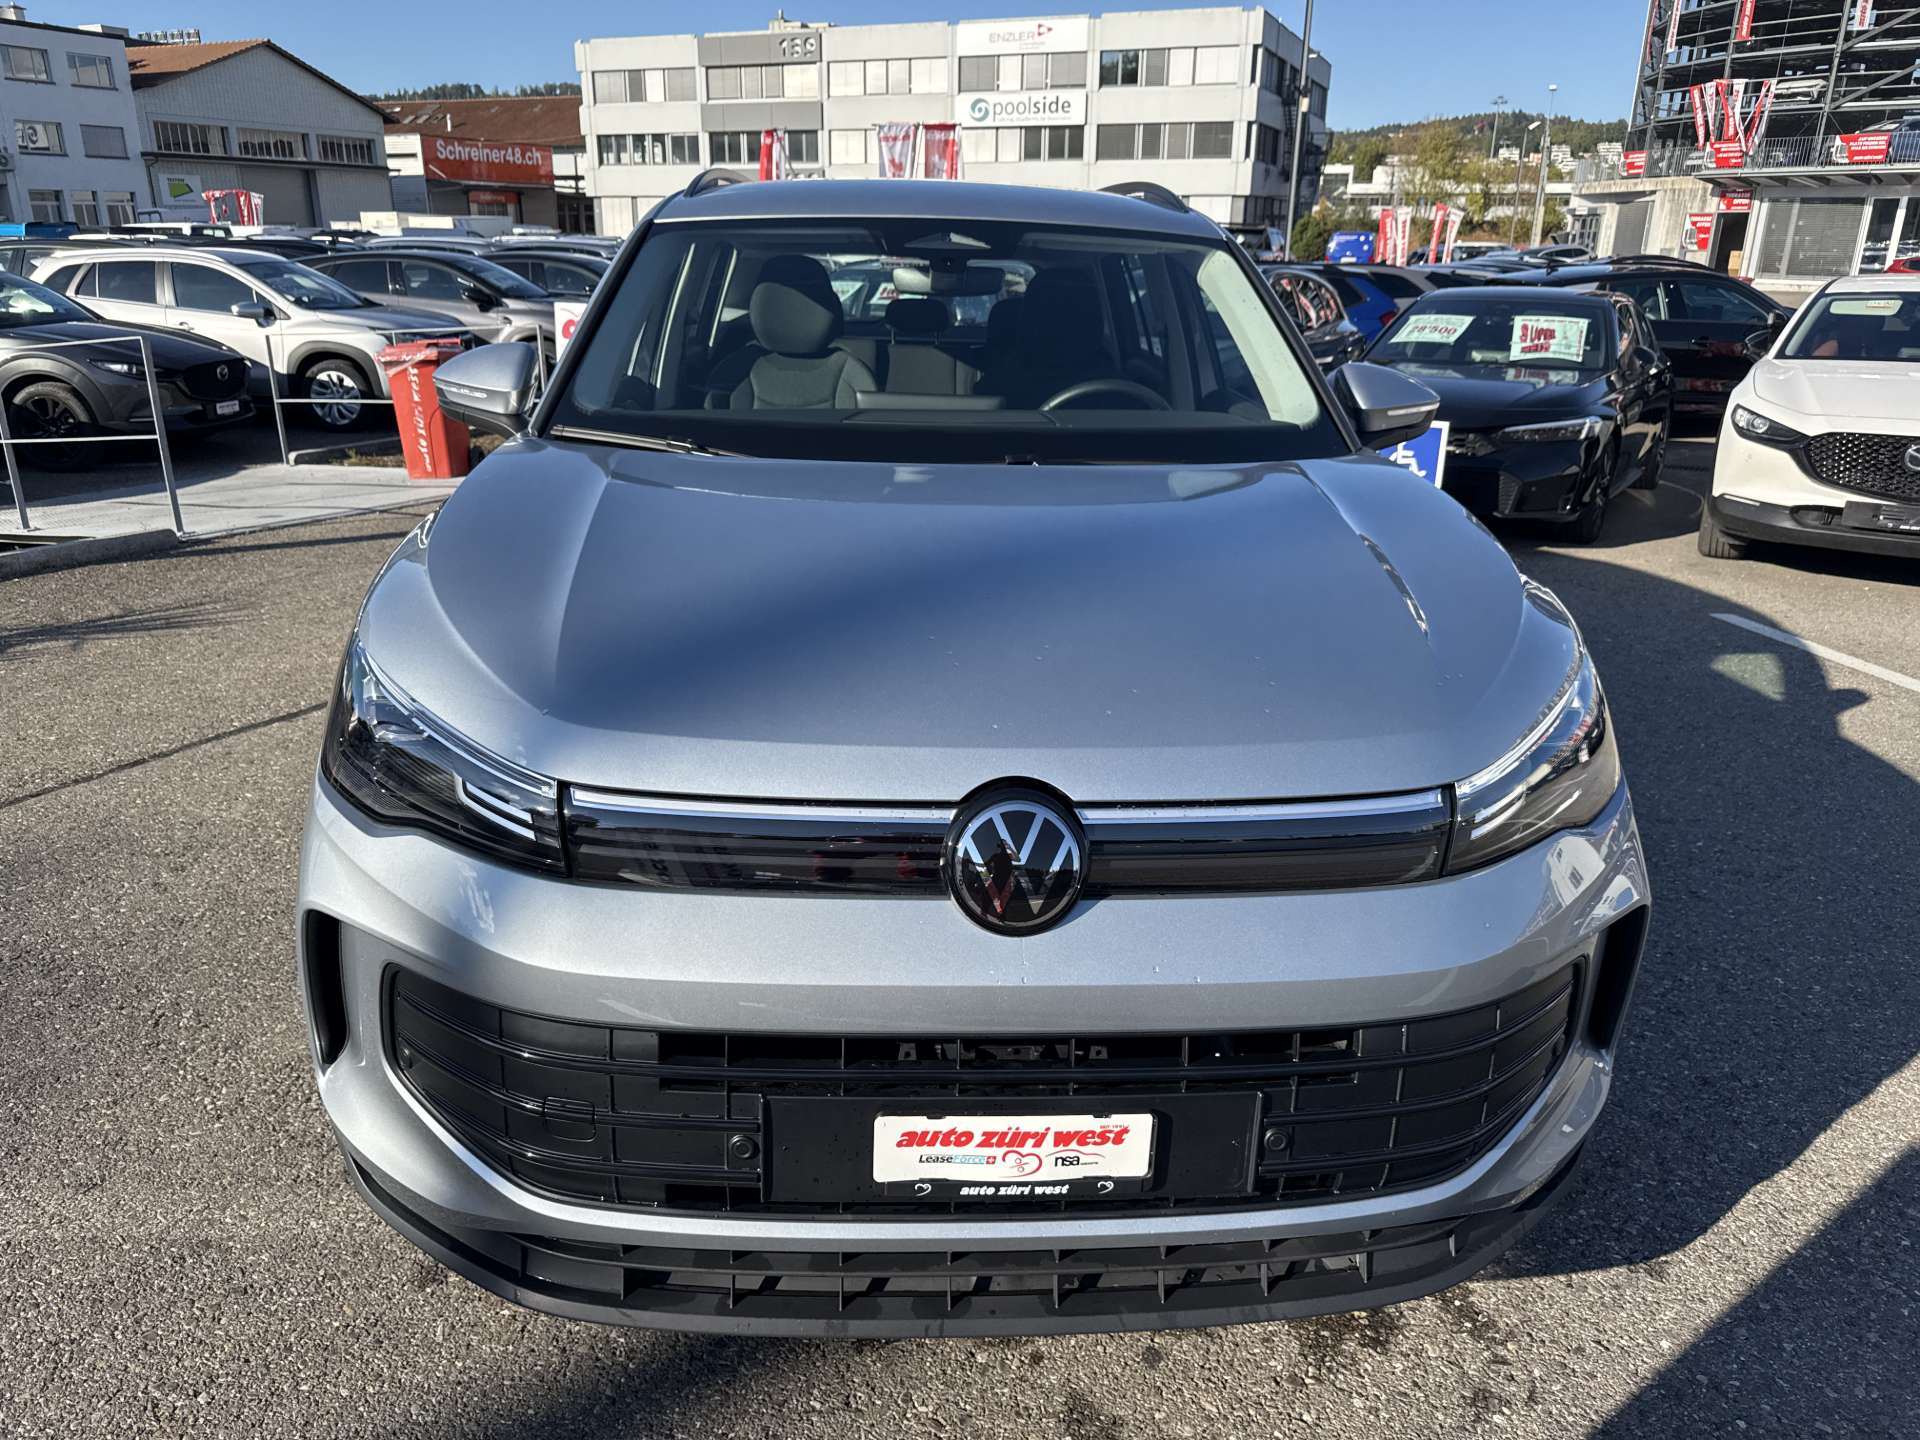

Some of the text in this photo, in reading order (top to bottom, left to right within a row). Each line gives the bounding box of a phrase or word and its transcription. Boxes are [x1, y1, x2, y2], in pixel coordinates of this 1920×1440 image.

[989, 31, 1036, 43] ENZLER
[993, 96, 1071, 122] poolside
[436, 139, 542, 165] Schreiner48.ch
[896, 1126, 1130, 1148] auto züri west
[919, 1154, 985, 1165] LeaseForce
[1054, 1156, 1080, 1167] nsa
[960, 1184, 1069, 1195] auto züri west
